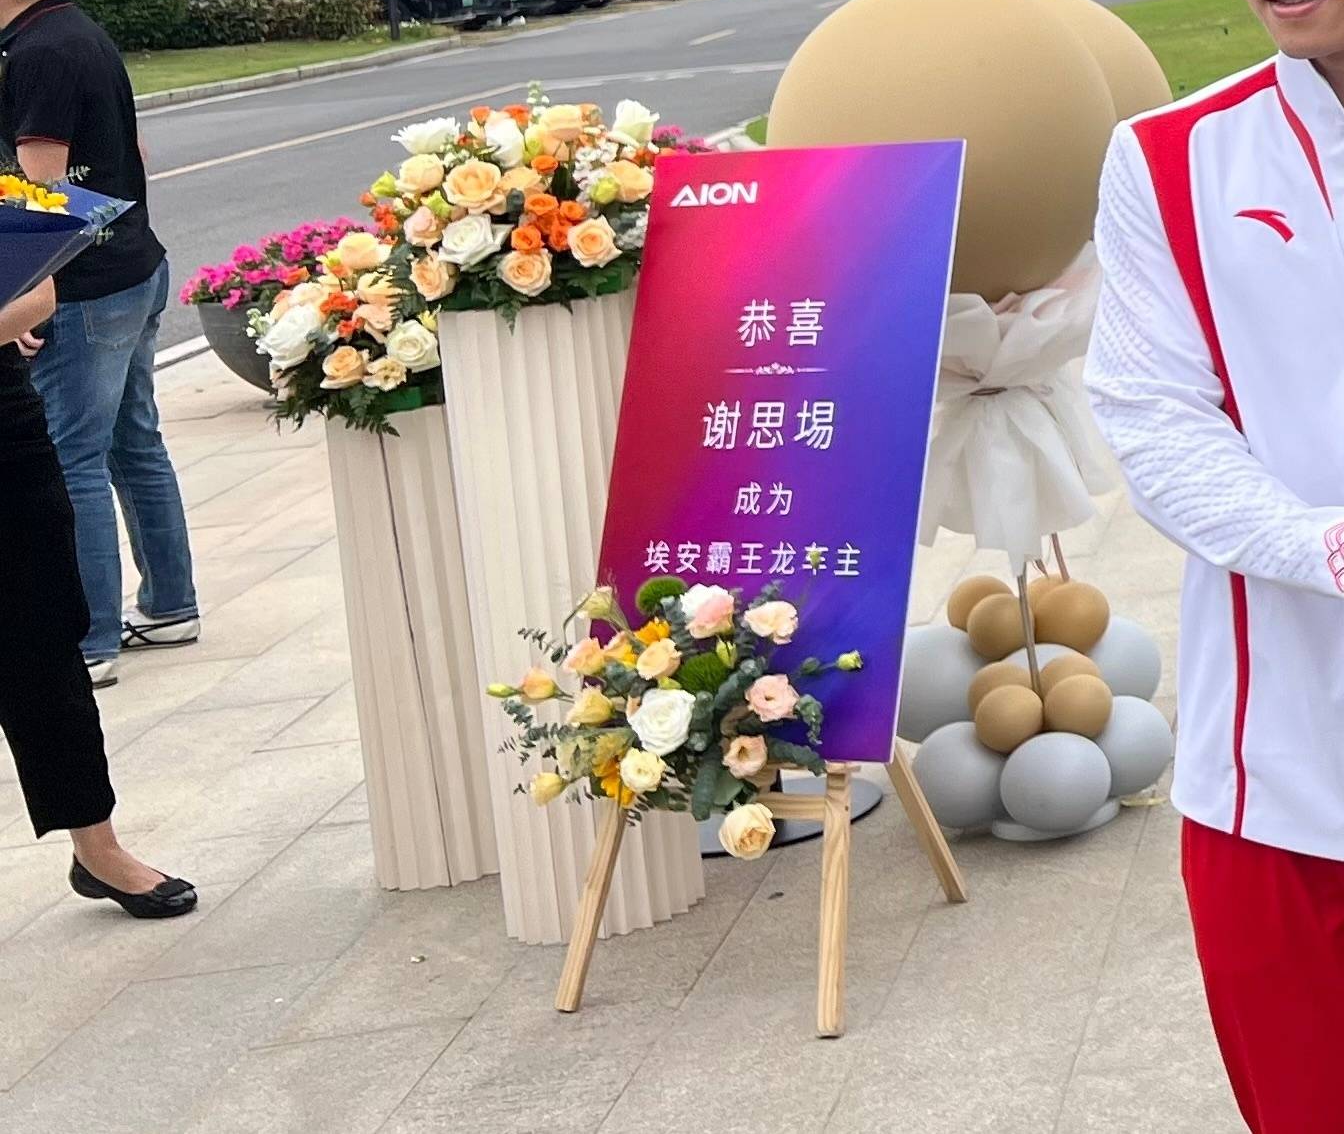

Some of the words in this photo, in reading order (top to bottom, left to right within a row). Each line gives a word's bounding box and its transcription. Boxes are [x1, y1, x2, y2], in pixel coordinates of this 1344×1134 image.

[670, 181, 758, 207] AION
[737, 297, 826, 348] 恭喜
[734, 481, 793, 516] 成为
[643, 539, 861, 577] 埃安霸王龙车主
